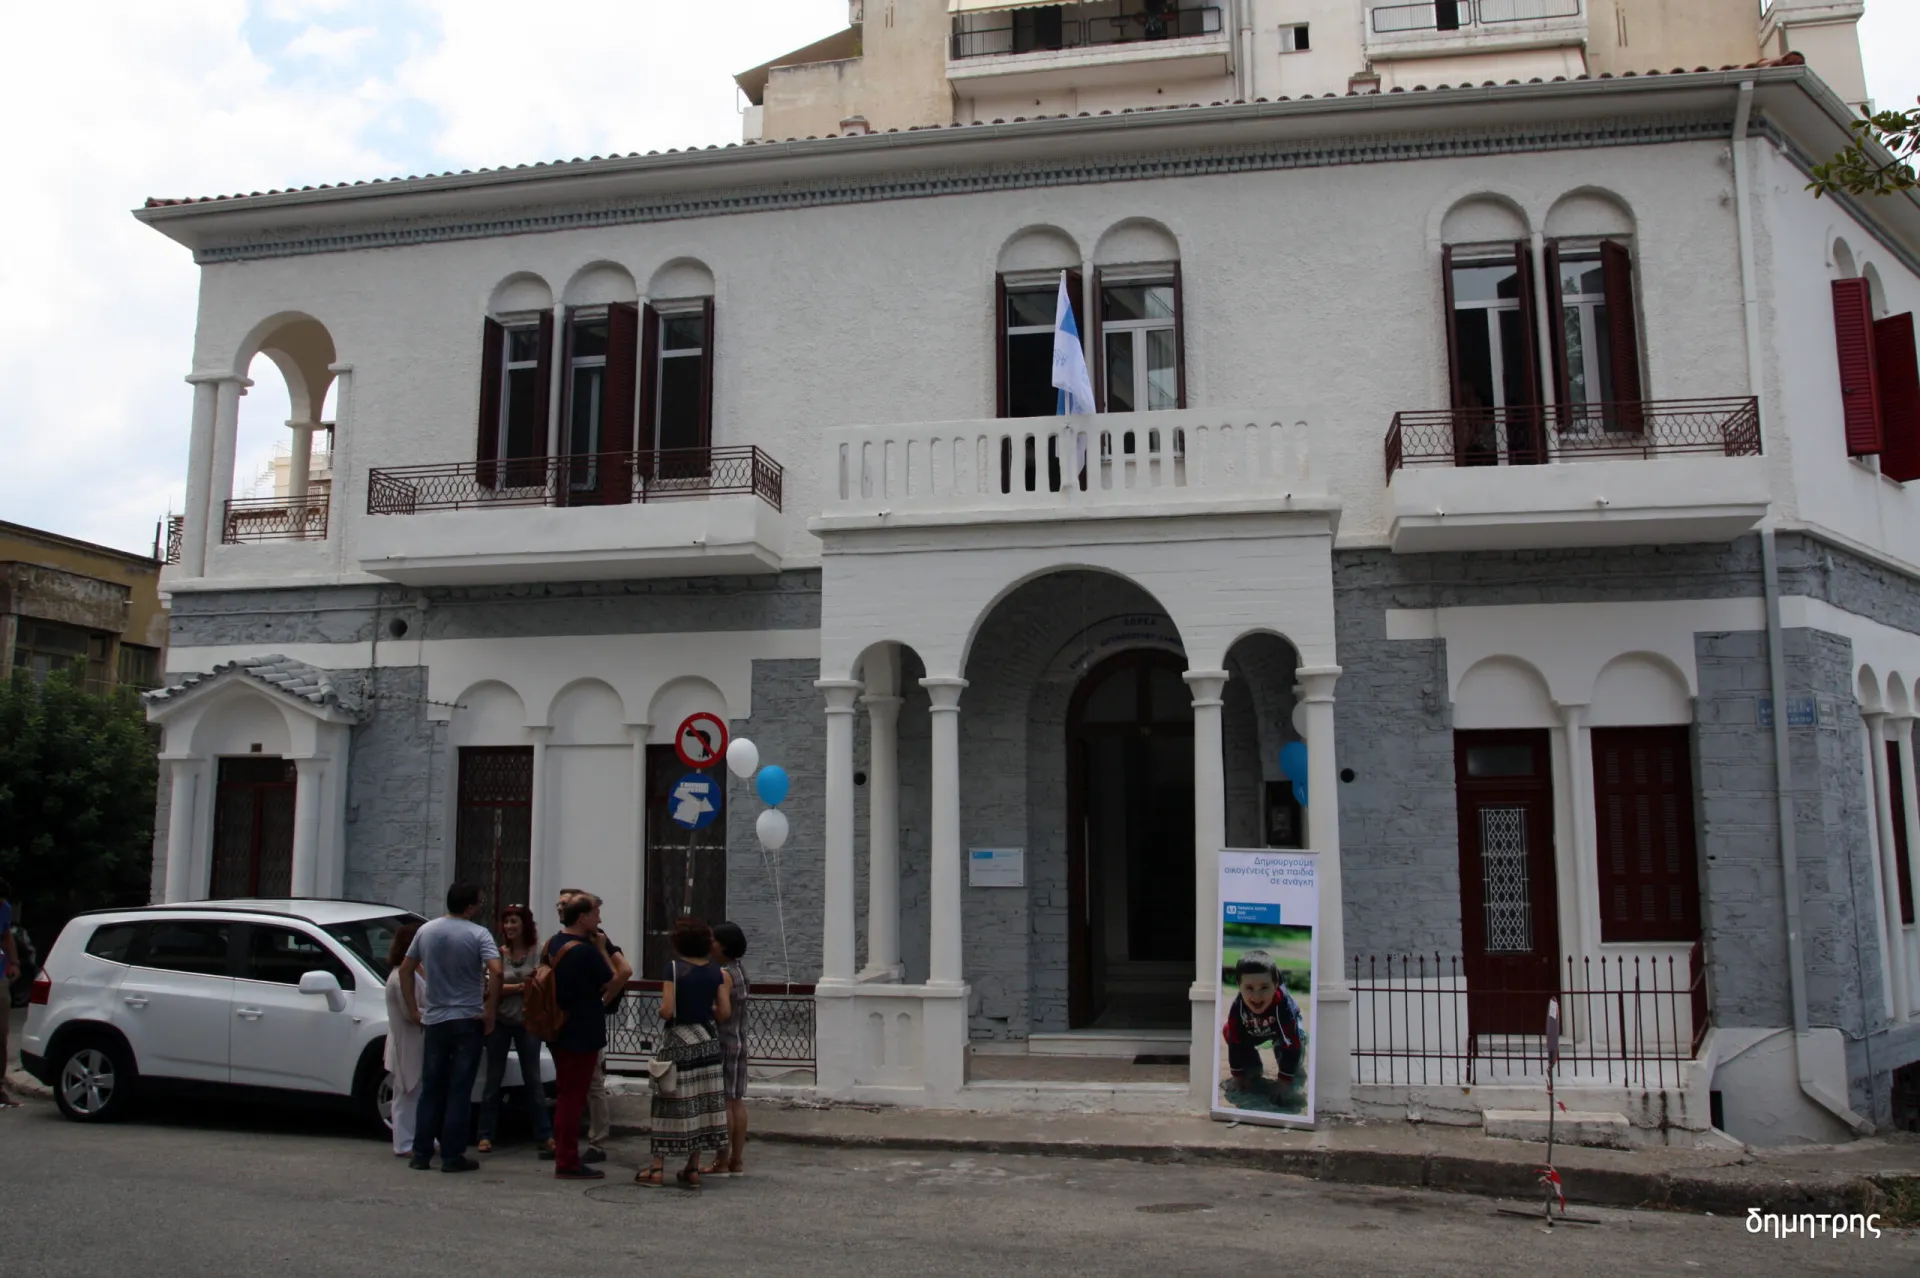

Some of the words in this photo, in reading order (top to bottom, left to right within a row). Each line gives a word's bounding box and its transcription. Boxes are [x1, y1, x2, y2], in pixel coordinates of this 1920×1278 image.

[1254, 857, 1314, 867] Δημιουργούμε
[1224, 866, 1270, 876] οικογένειες
[1272, 868, 1284, 876] για
[1287, 868, 1314, 876] παιδιά
[1282, 878, 1314, 887] ανάγκη
